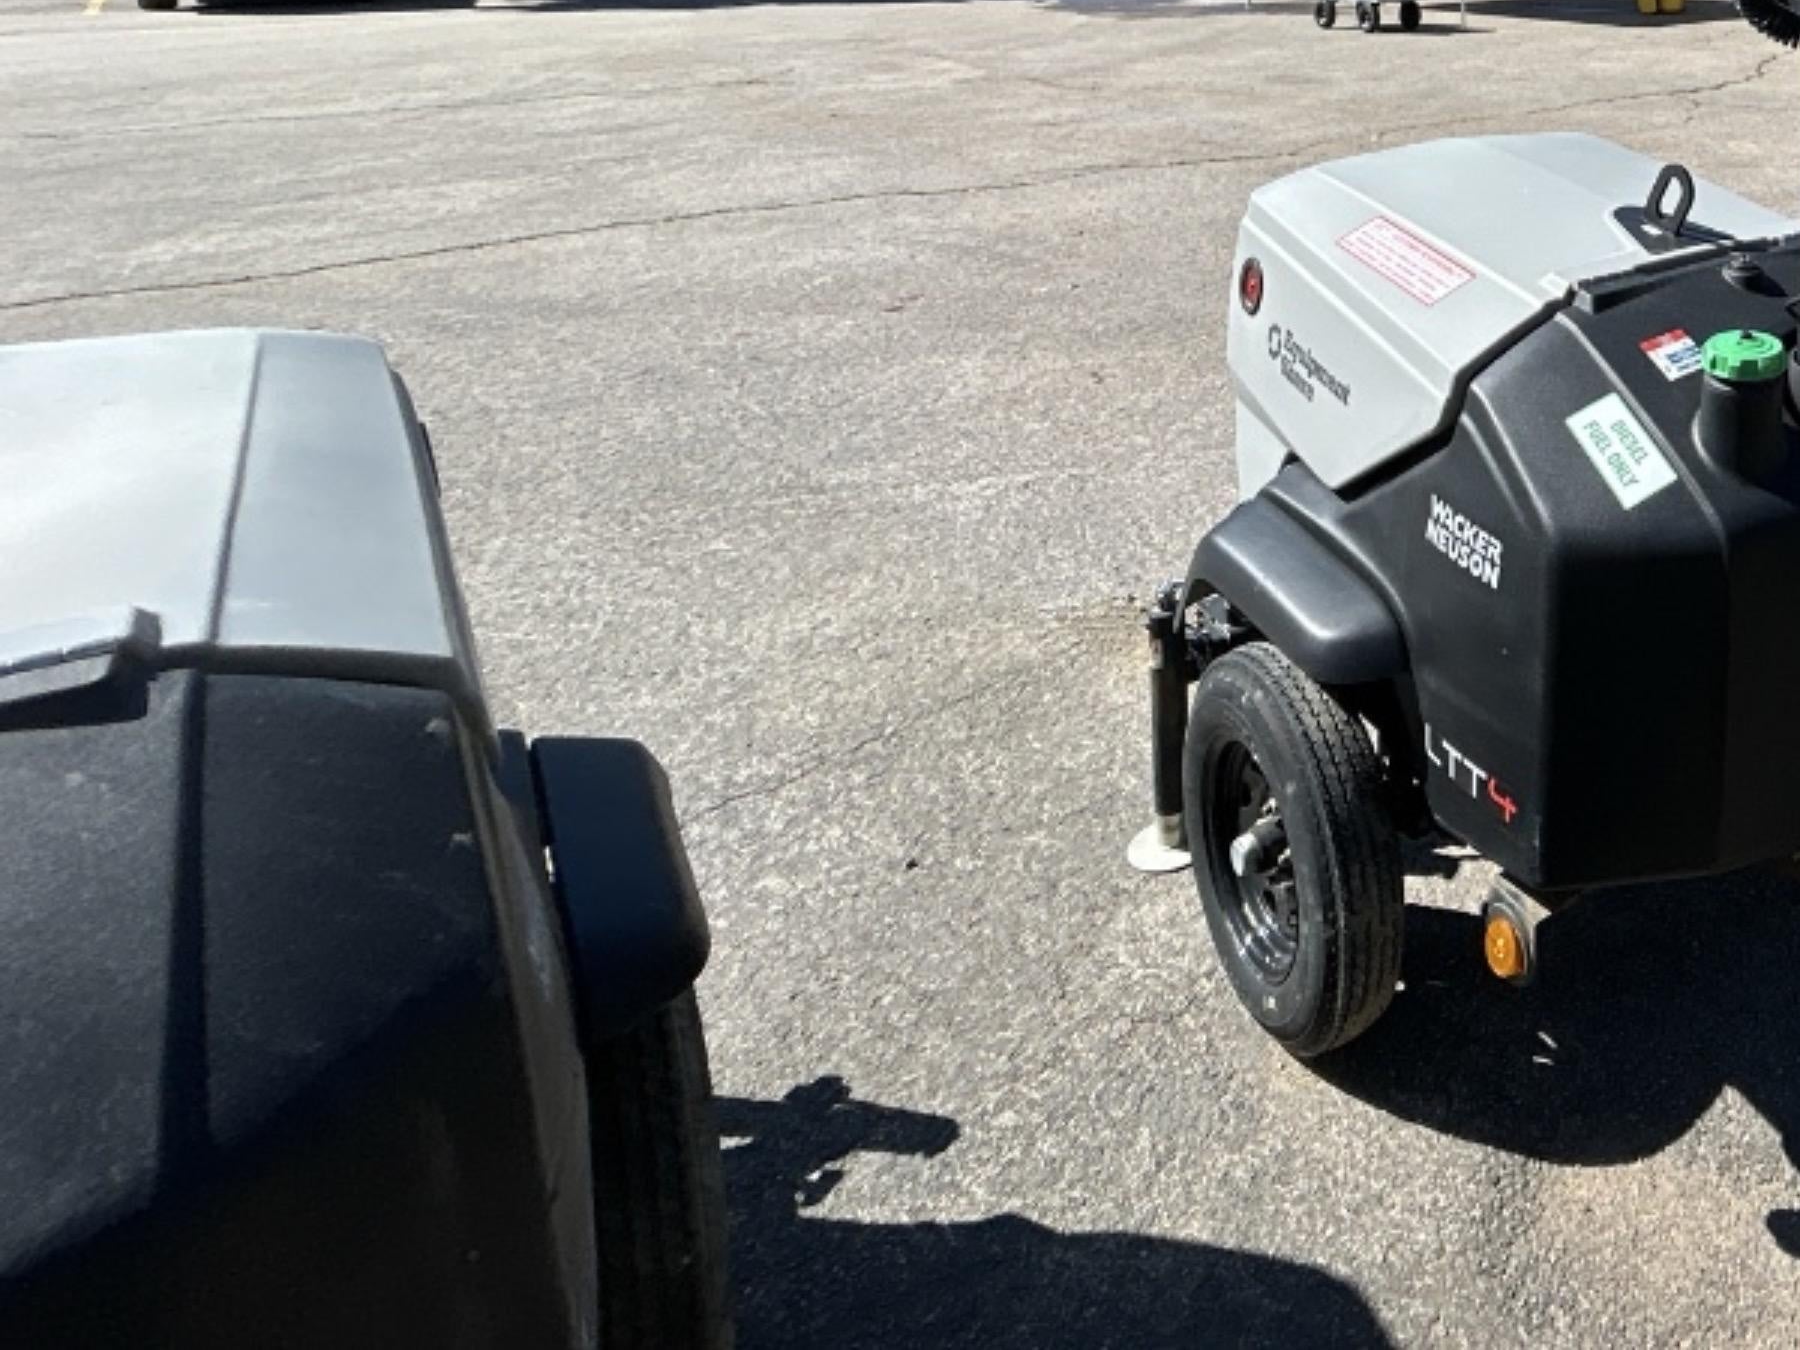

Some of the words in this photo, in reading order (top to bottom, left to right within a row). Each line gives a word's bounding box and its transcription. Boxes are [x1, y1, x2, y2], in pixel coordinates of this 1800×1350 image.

[1583, 419, 1613, 458] FUEL
[1606, 452, 1640, 488] ONLY
[1610, 419, 1649, 466] DIESEL
[1424, 518, 1500, 589] NEUSON
[1430, 493, 1503, 566] WACKER
[1424, 721, 1517, 824] LTT4
